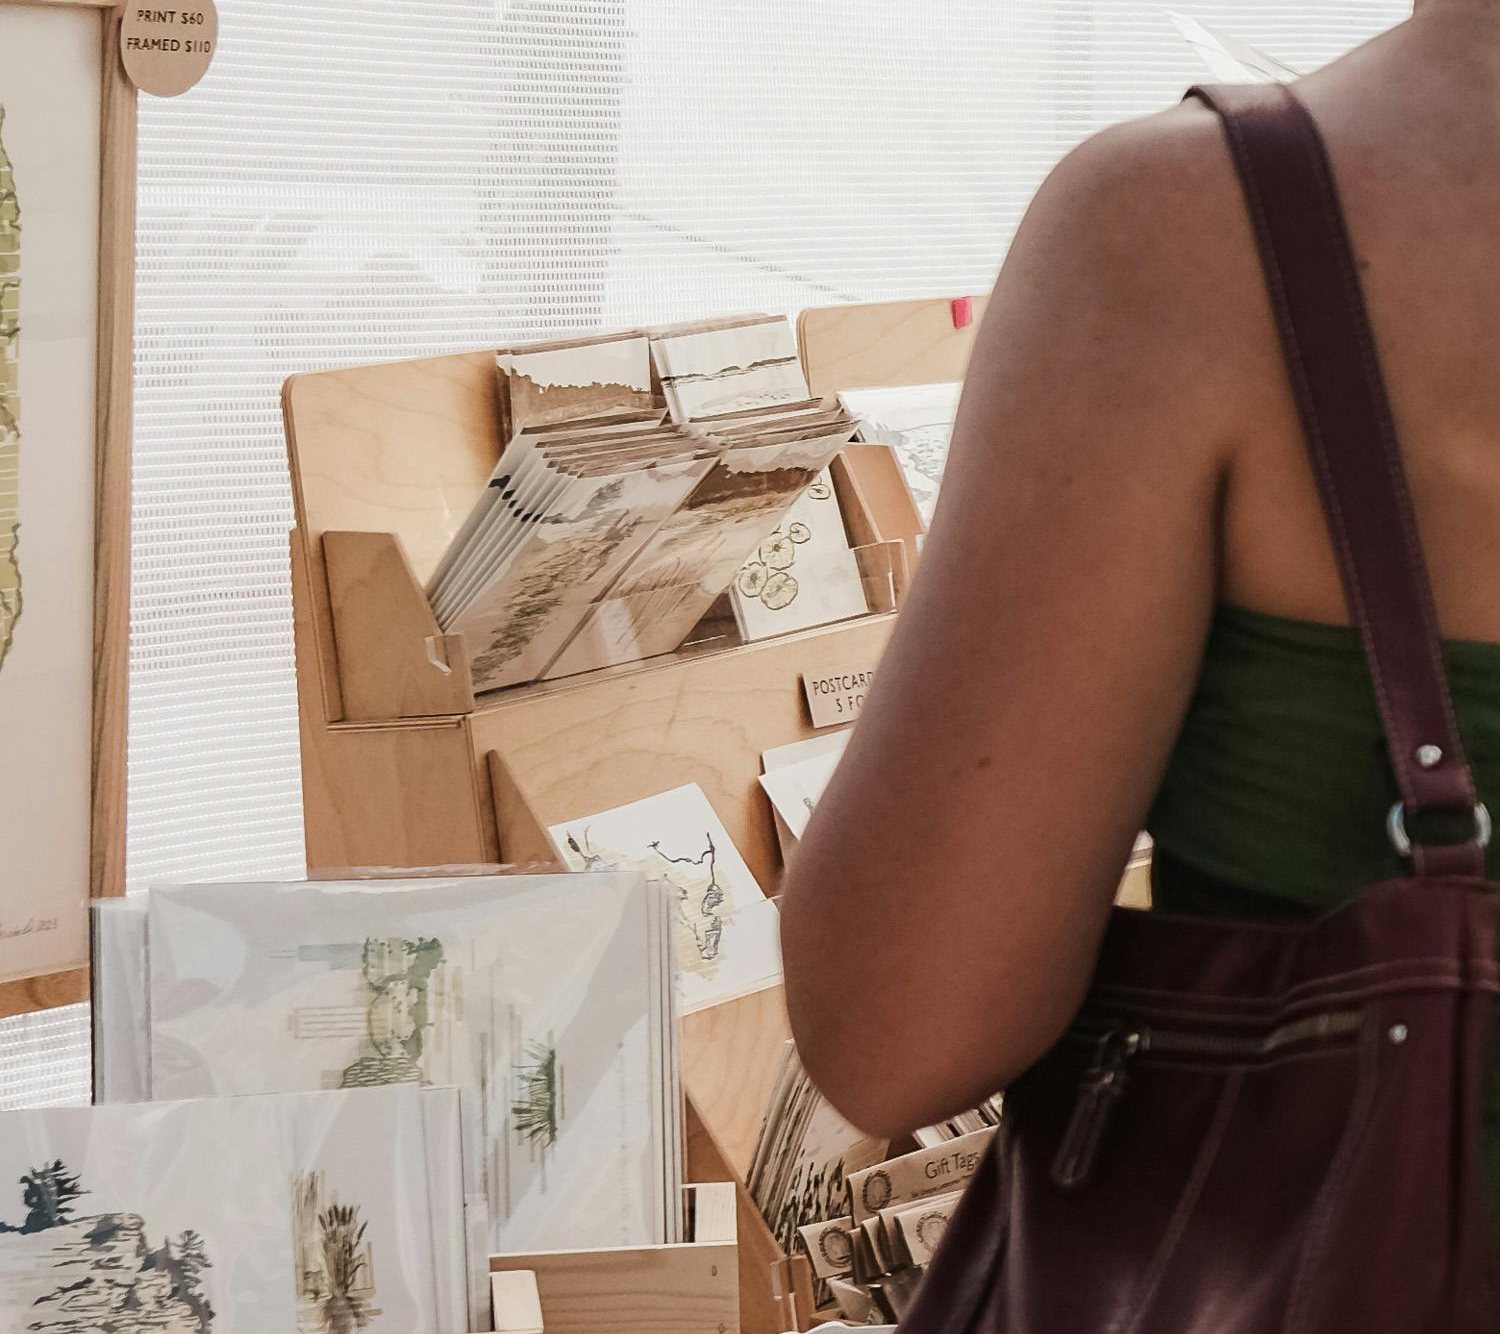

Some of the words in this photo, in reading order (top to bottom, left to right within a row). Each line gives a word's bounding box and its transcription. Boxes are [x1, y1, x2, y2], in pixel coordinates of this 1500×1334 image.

[137, 10, 176, 23] PRINT
[127, 37, 180, 51] FRAMED
[925, 1157, 951, 1179] Gift
[952, 1152, 980, 1172] Tags
